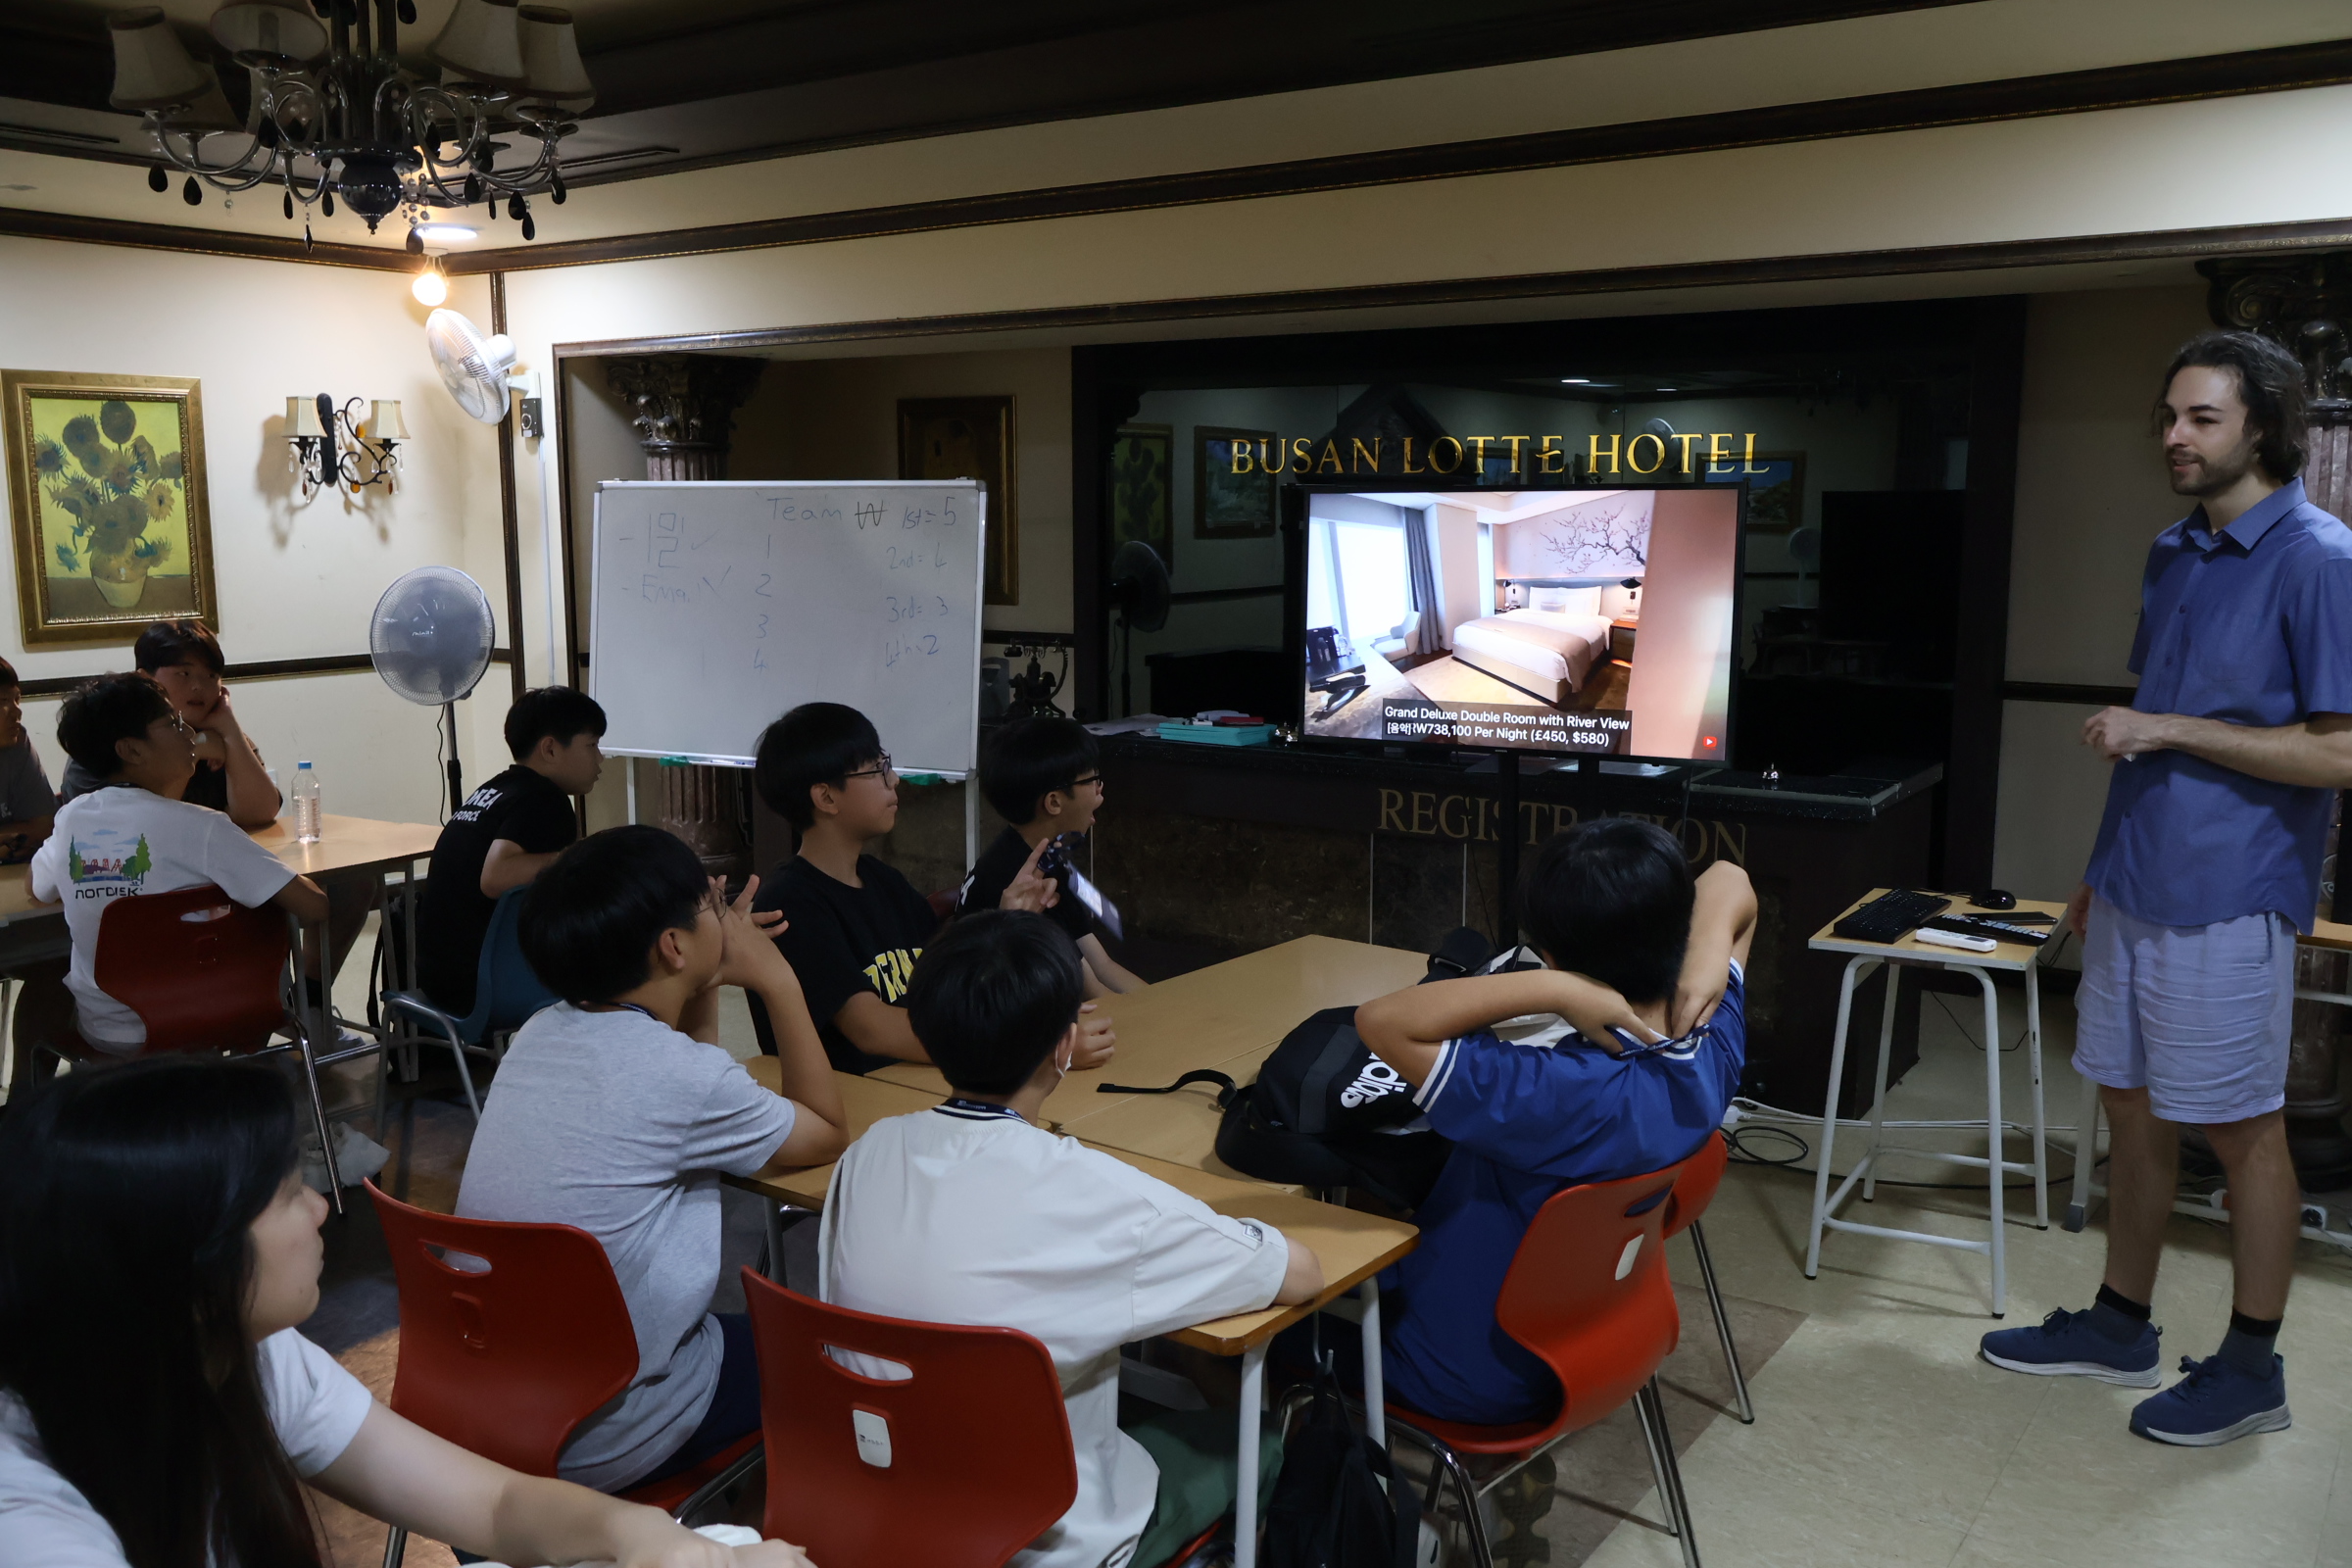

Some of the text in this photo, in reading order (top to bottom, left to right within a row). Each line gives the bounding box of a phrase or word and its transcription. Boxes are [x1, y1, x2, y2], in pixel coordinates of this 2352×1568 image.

[1230, 433, 1771, 474] BUSAN LOTTE HOTEL
[766, 497, 842, 521] Team
[943, 496, 957, 526] 5
[755, 573, 772, 598] 2
[936, 595, 950, 616] 3
[756, 613, 769, 639] 3
[922, 634, 940, 656] 2
[753, 648, 767, 675] 4
[1385, 706, 1630, 730] Grand Deluxe Double Room with River View
[1475, 726, 1494, 738] Per
[1496, 727, 1528, 742] Night
[1531, 729, 1569, 745] (£450,
[1572, 730, 1609, 747] $580)
[1377, 788, 1747, 868] REGITRON
